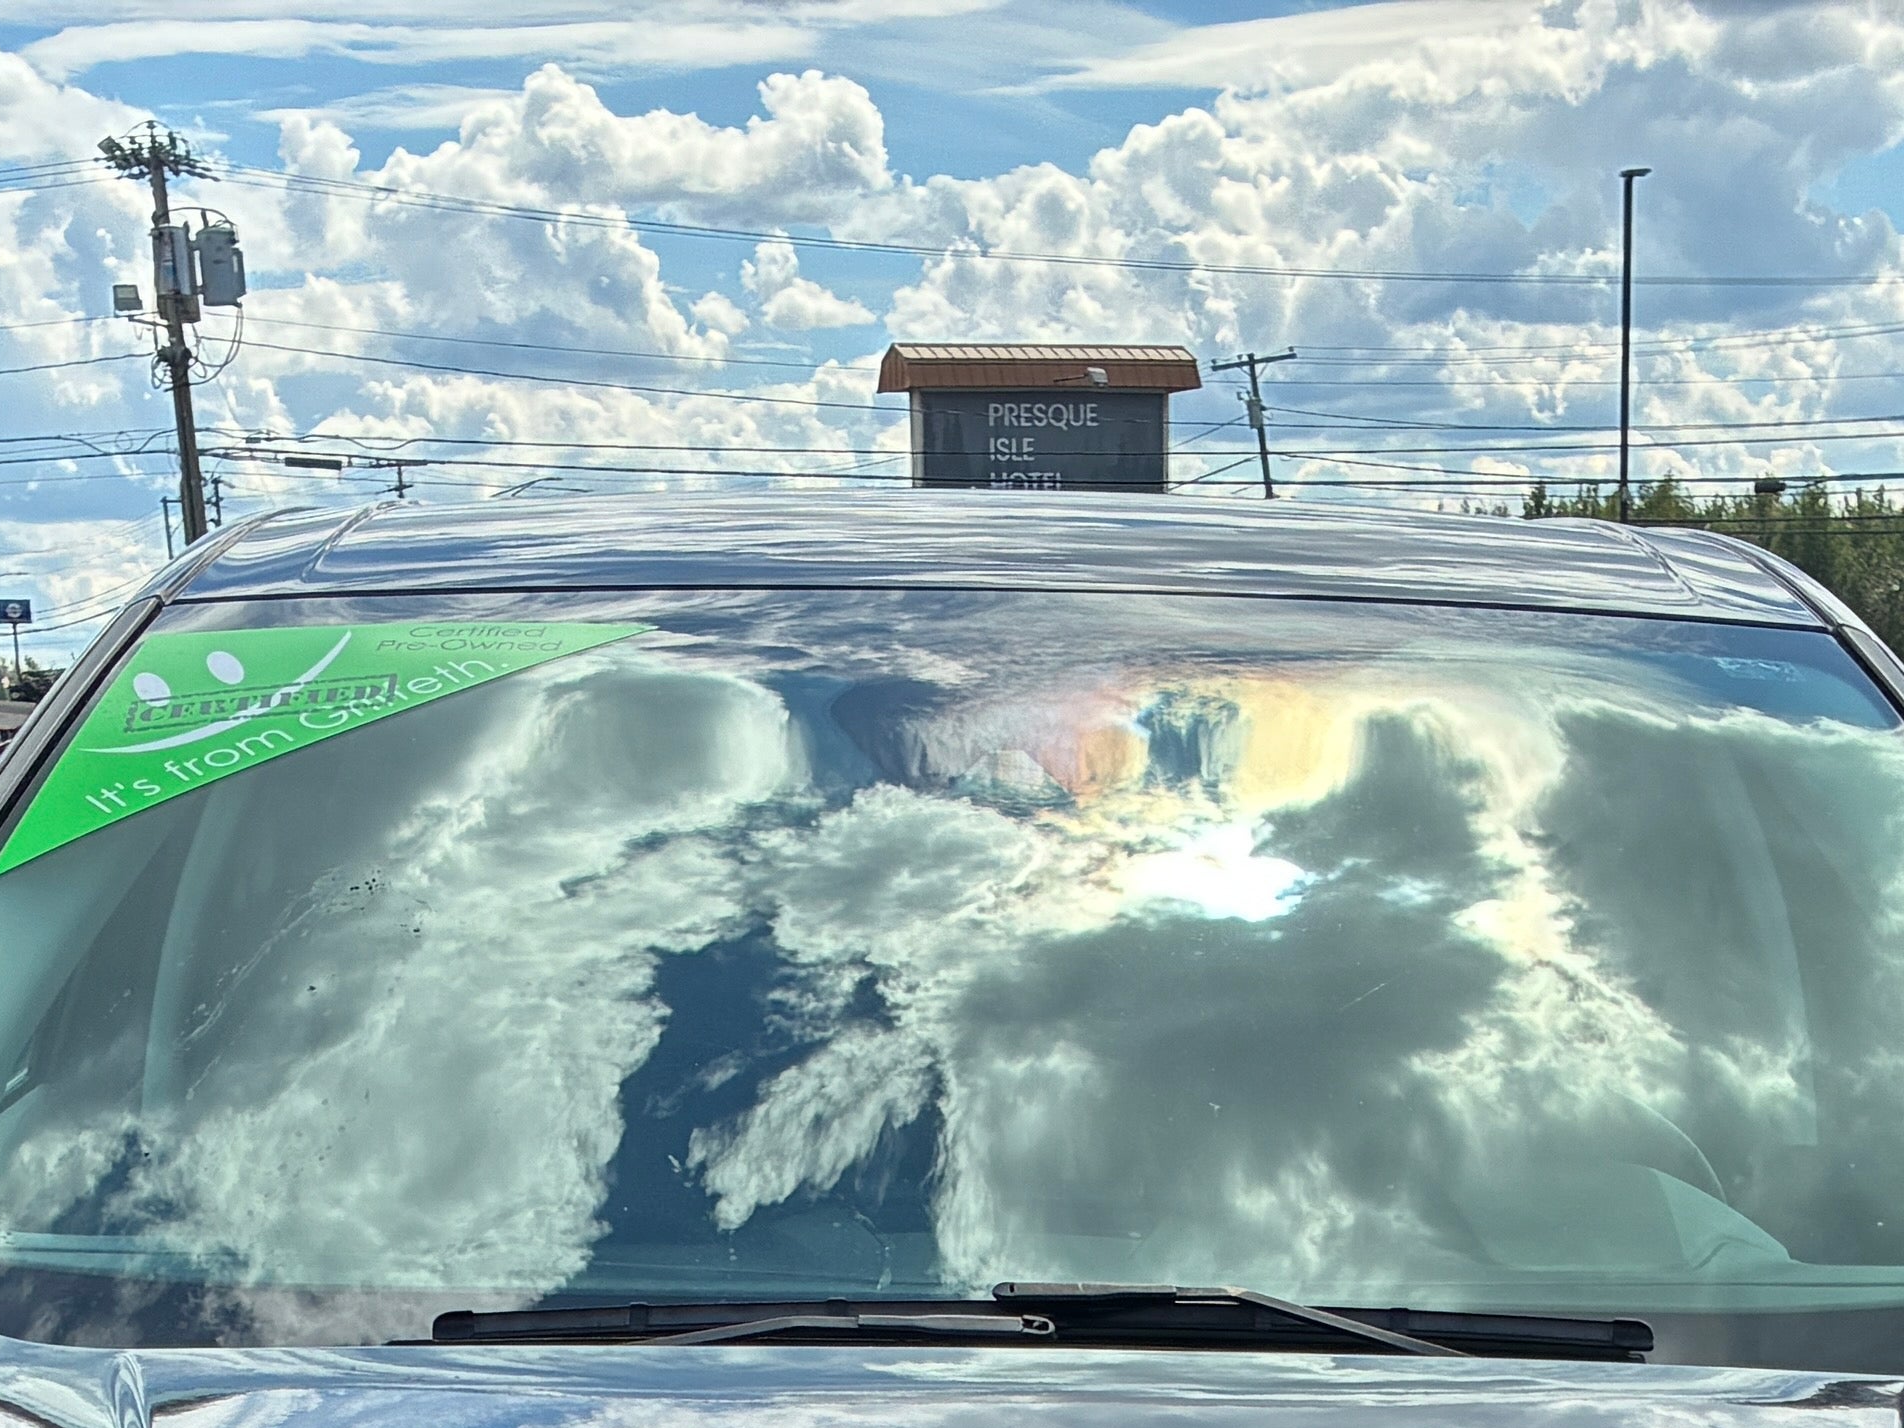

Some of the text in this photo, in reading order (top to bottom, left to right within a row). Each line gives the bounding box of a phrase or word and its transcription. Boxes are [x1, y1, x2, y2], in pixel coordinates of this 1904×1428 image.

[988, 402, 1100, 431] PRESQUE
[989, 437, 1036, 461] ISLE
[409, 626, 547, 638] Certified
[376, 639, 563, 651] Pre-Owned
[85, 778, 161, 814] It's
[163, 729, 294, 782] from
